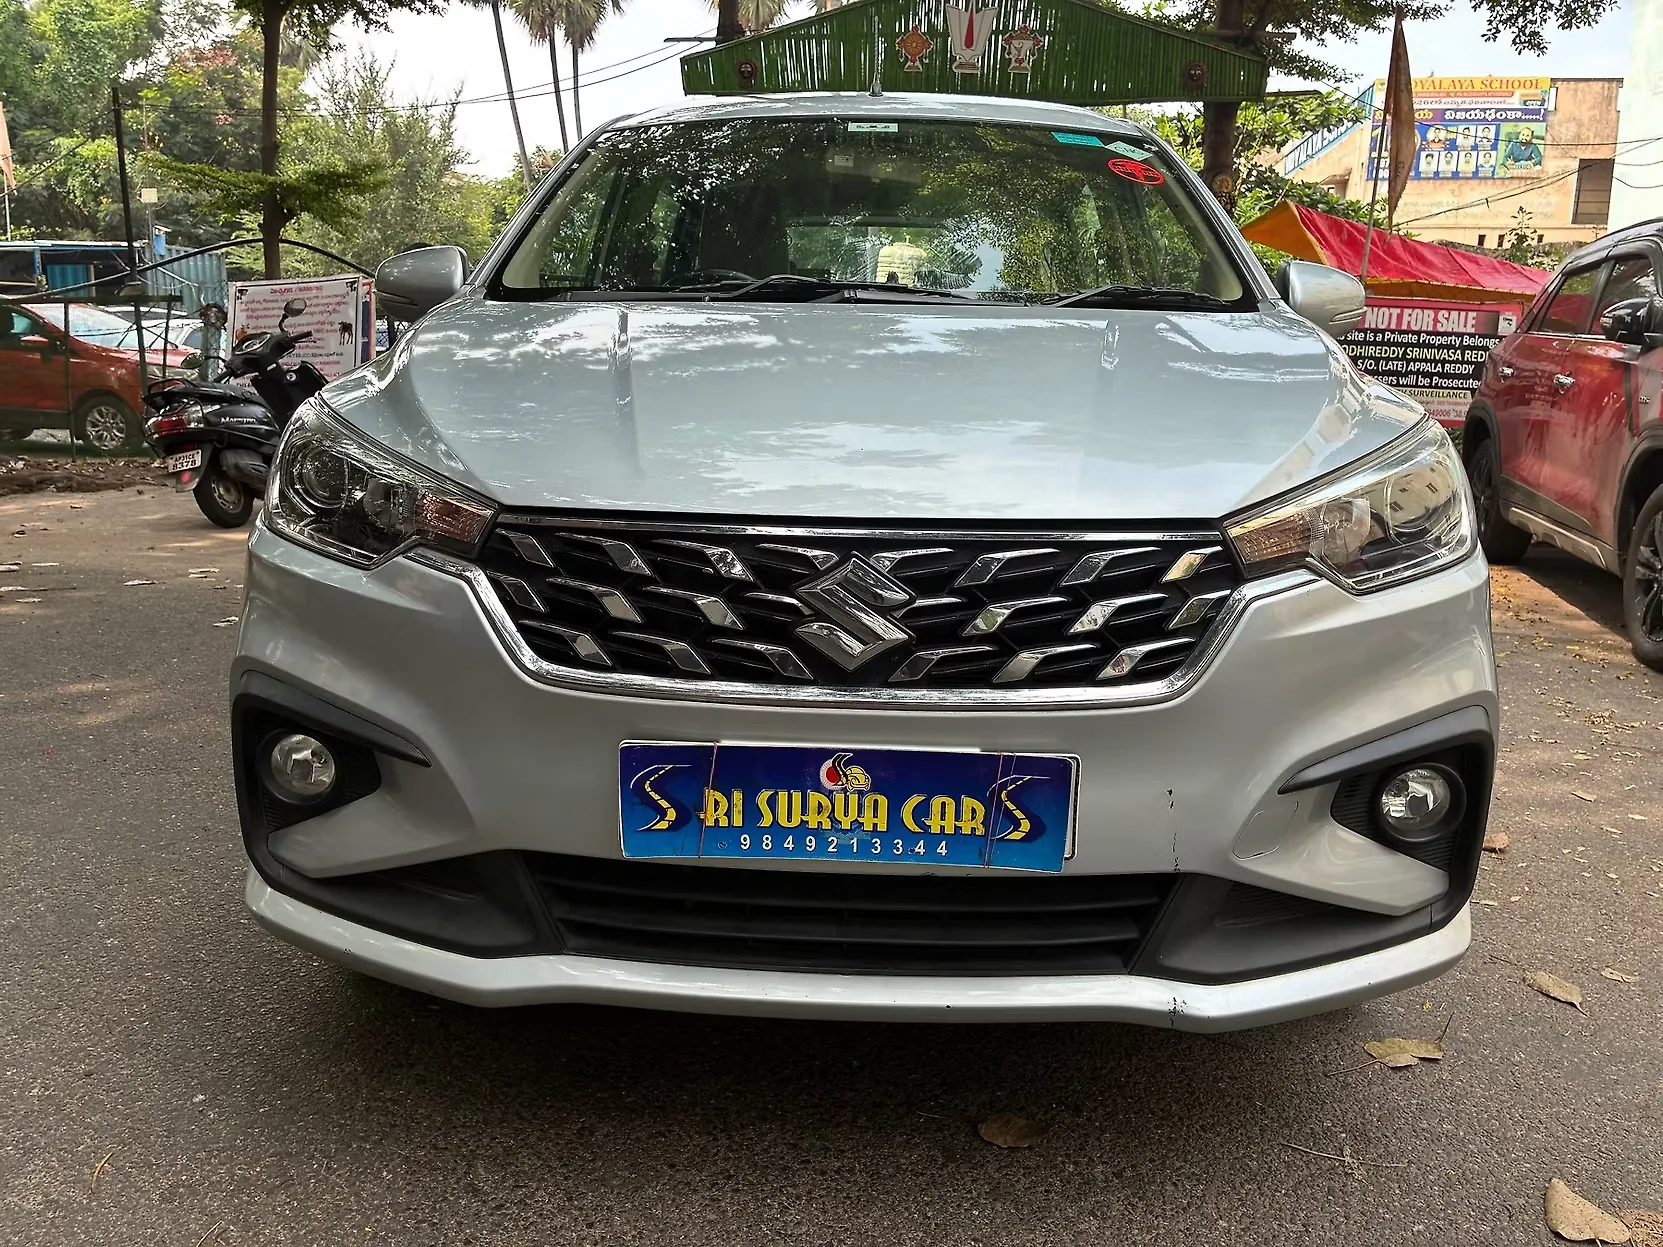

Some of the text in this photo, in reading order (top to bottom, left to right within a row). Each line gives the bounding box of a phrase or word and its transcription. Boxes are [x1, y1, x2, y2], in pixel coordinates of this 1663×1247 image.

[1481, 78, 1544, 90] SCHOOL
[1365, 307, 1476, 332] NOT FOR SALE
[1346, 330, 1364, 341] site
[1366, 331, 1375, 342] is
[1376, 334, 1382, 342] a
[1384, 331, 1418, 344] Private
[1420, 334, 1461, 347] Property
[1463, 335, 1500, 349] Belongs
[1342, 345, 1404, 359] ODHIREDDY
[1406, 348, 1462, 361] SRINIVASA
[1357, 359, 1475, 375] S/O. (LATE) APPALA REDDY
[1398, 373, 1416, 386] will
[1417, 375, 1430, 386] be
[1432, 377, 1481, 389] Prosecute
[1409, 390, 1468, 399] SURVEILLANCE
[172, 460, 197, 471] 8378
[757, 789, 887, 833] SURYA
